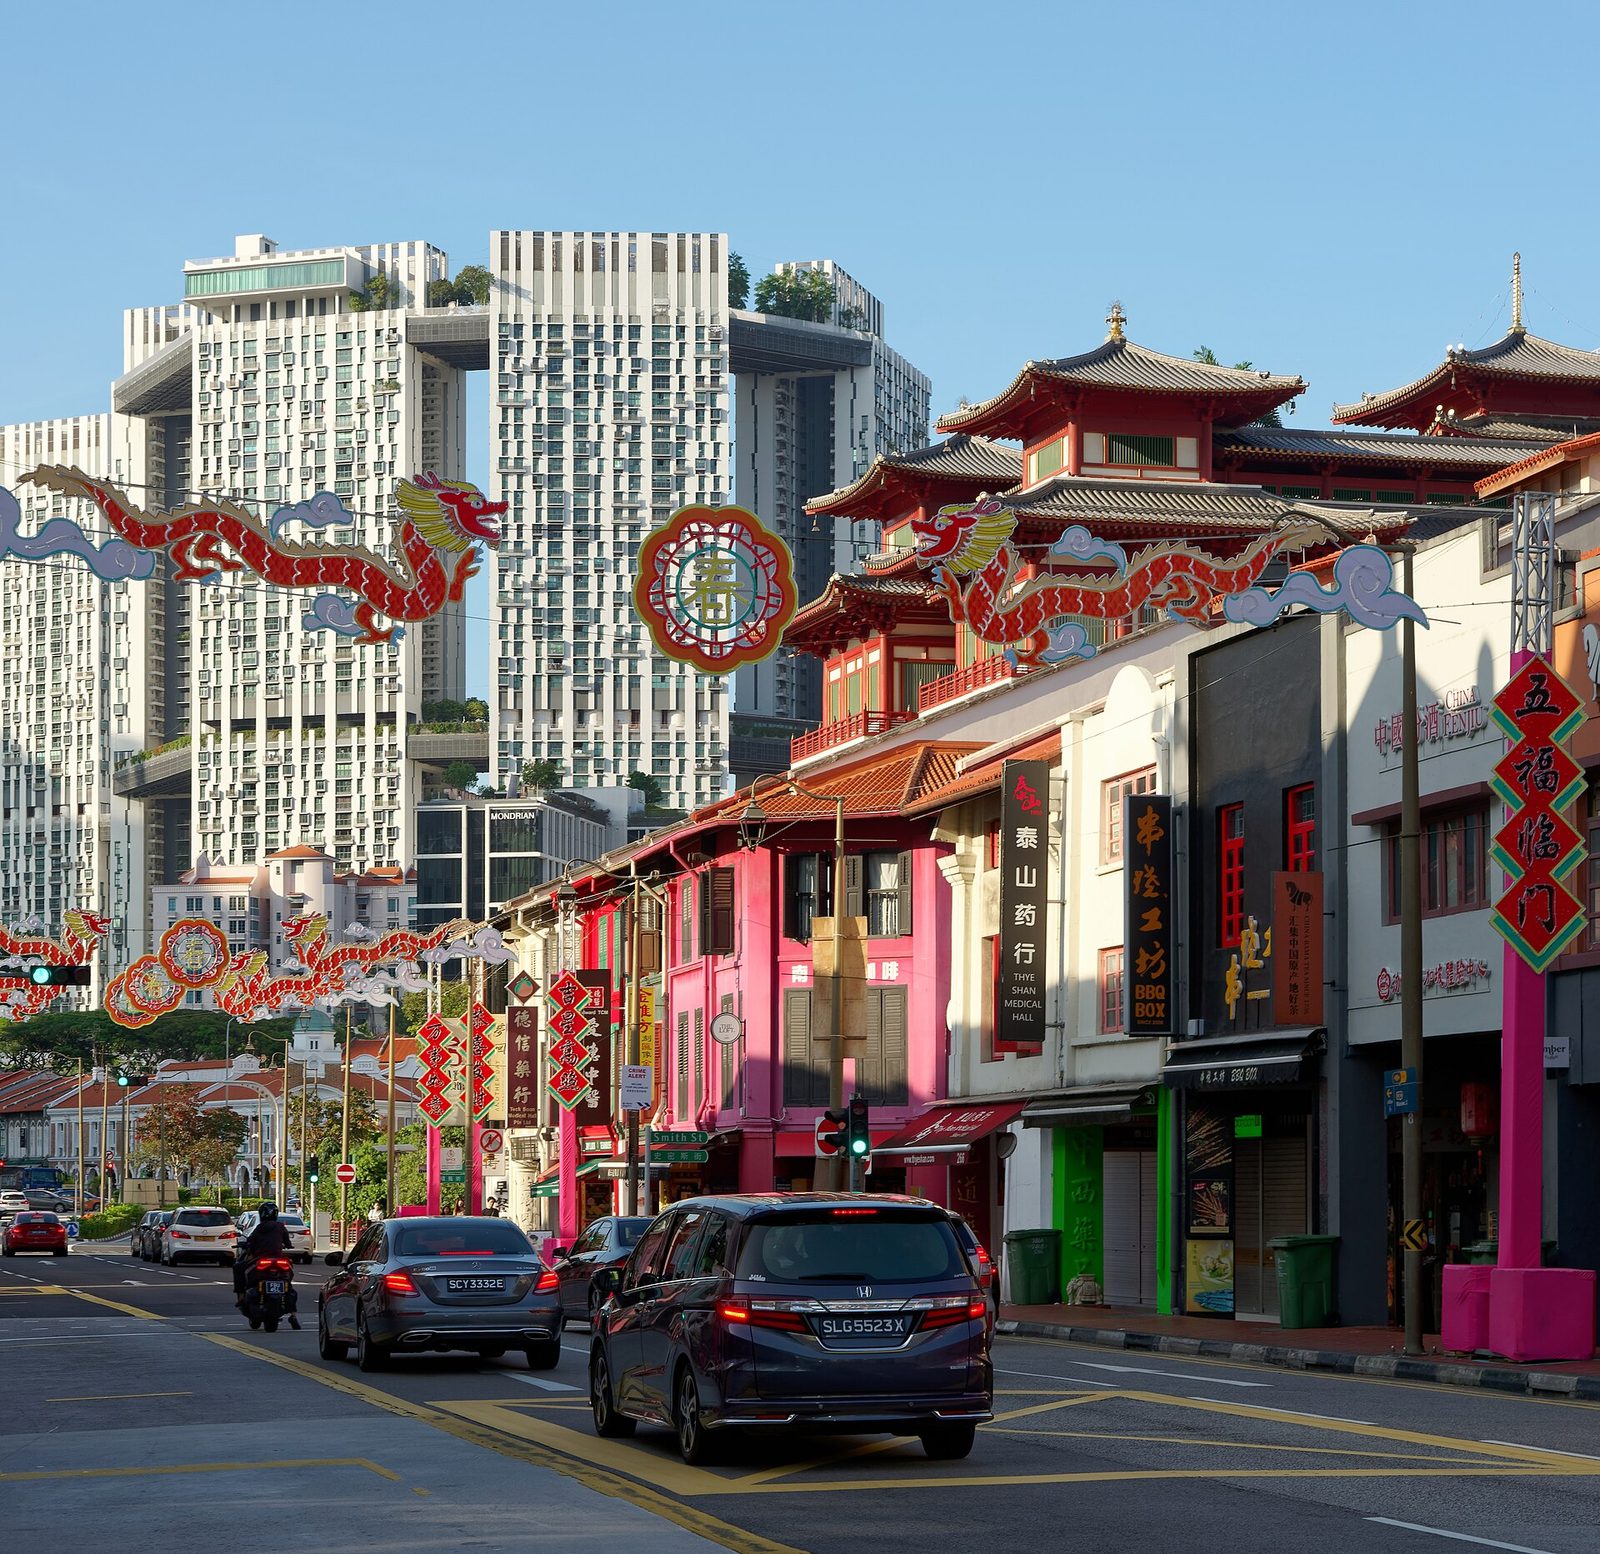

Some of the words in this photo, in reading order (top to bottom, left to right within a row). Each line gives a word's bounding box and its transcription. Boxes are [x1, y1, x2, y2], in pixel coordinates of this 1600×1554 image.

[684, 550, 750, 624] 春
[1446, 688, 1476, 709] CHINA
[1444, 707, 1484, 737] FENJIU
[490, 812, 535, 820] MONDRIAN
[1013, 826, 1038, 964] 泰山药行
[1013, 973, 1035, 982] THYE
[1012, 986, 1036, 995] SHAN
[1135, 984, 1166, 1000] BBQ
[1004, 1000, 1042, 1009] MEDICAL
[1135, 1002, 1166, 1018] BOX
[1012, 1013, 1034, 1022] HALL
[555, 981, 581, 1092] 吉星高照
[514, 1010, 531, 1104] 德信藥行
[1231, 1068, 1244, 1081] BBQ
[1245, 1067, 1258, 1080] BOX
[653, 1132, 687, 1142] Smith
[691, 1132, 702, 1142] St
[449, 1279, 504, 1289] SCY3332E
[822, 1319, 904, 1333] SLG5523X
